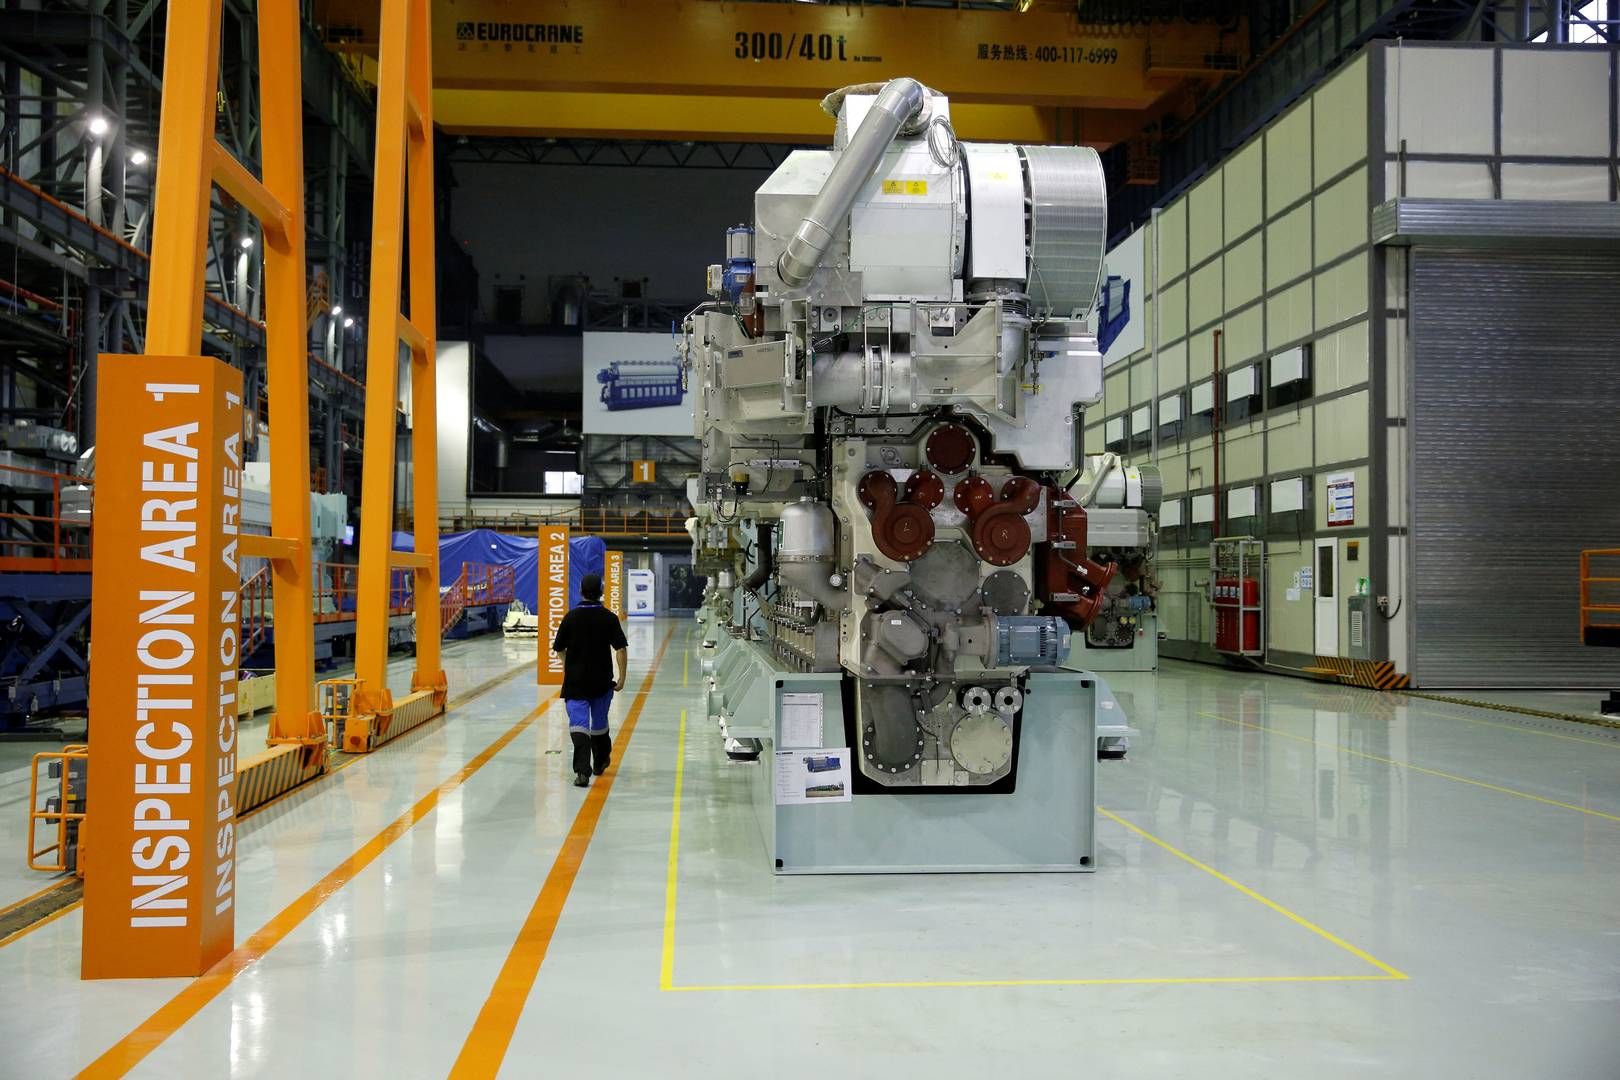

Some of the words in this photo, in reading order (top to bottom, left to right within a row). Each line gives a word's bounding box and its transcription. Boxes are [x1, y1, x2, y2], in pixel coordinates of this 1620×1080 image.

[477, 23, 583, 43] EUROCRANE
[735, 32, 847, 61] 300/40t
[1035, 46, 1118, 64] 400-117-6999
[146, 383, 200, 402] 1
[226, 391, 240, 409] 1
[639, 462, 648, 481] 1
[140, 422, 200, 574] AREA
[222, 432, 240, 573] AREA
[550, 532, 565, 541] 2
[549, 544, 565, 583] AREA
[611, 562, 620, 585] AREA
[611, 586, 620, 614] ECTION
[131, 591, 195, 928] INSPECTION
[215, 591, 237, 917] INSPECTION
